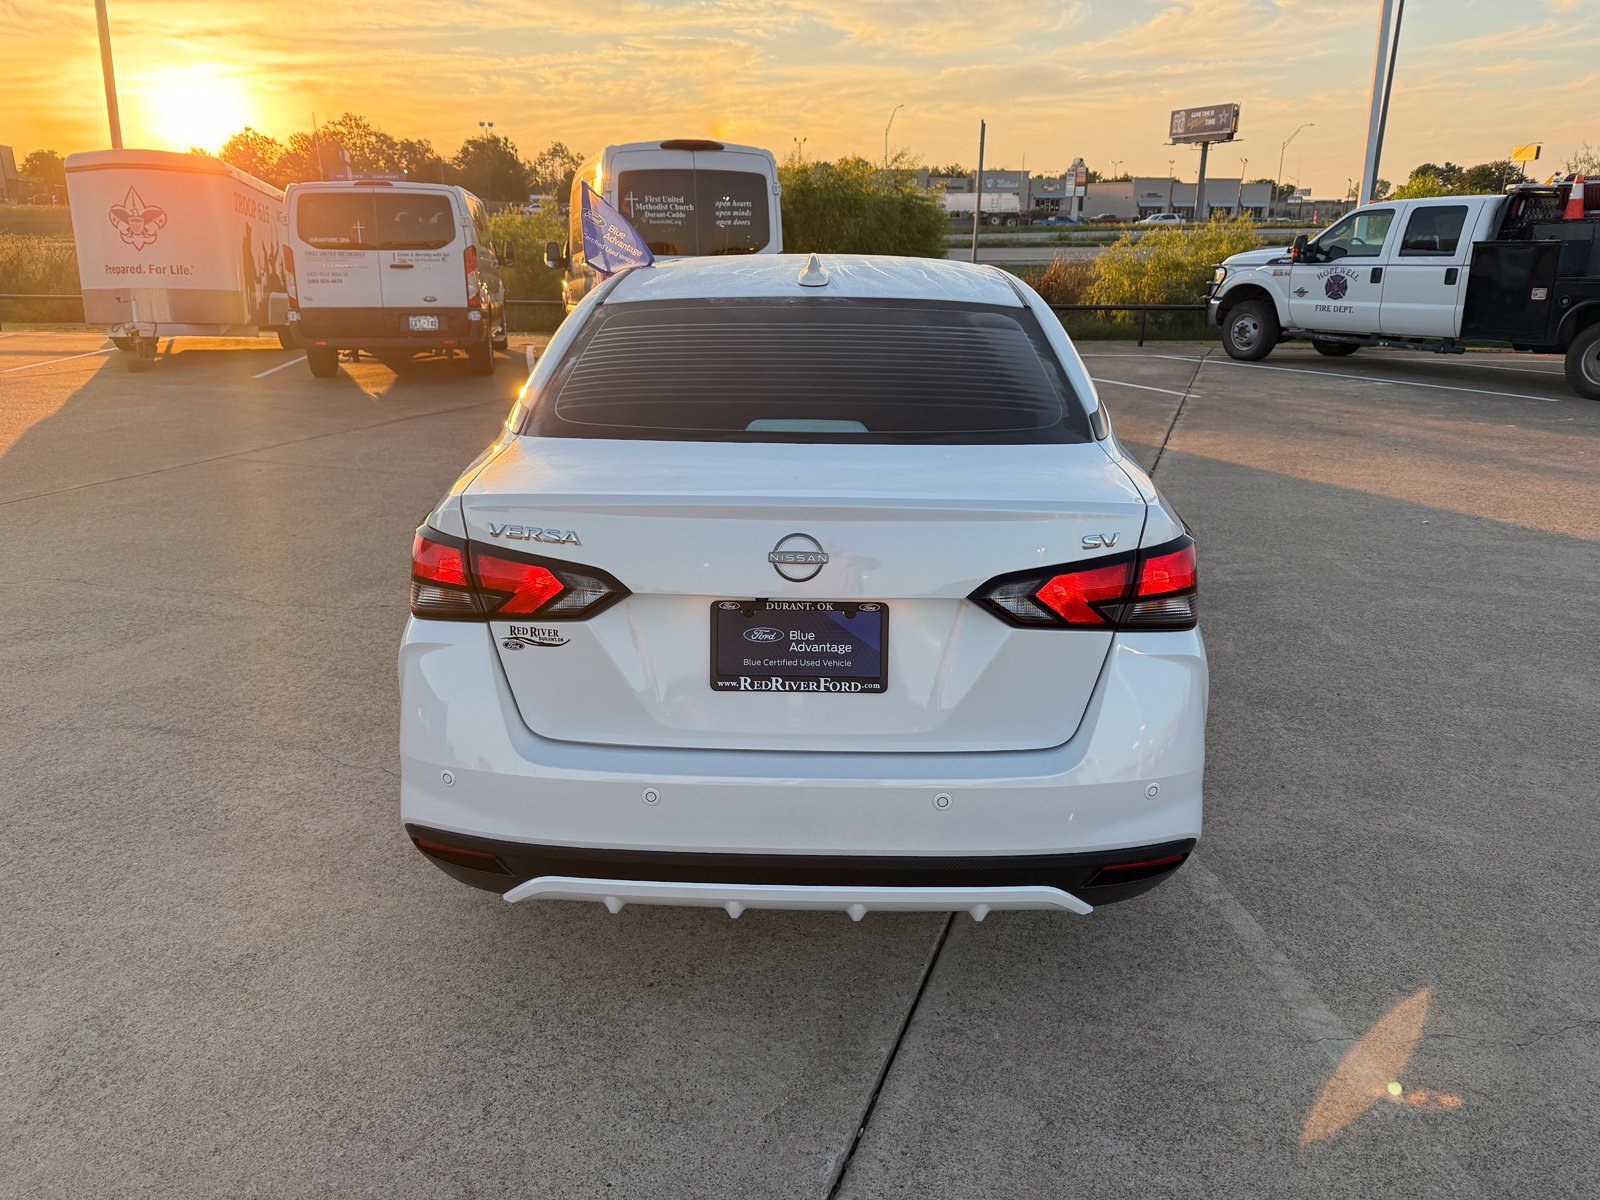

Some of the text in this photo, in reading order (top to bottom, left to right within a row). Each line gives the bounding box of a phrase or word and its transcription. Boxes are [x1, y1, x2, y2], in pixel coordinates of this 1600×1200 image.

[232, 191, 256, 218] TROOP
[608, 224, 626, 239] Blue
[584, 232, 636, 266] Certified Used Vehicle
[603, 233, 643, 256] Advantage
[105, 264, 146, 276] Prepared.
[149, 264, 166, 275] For
[1316, 266, 1360, 281] HOPEWELL
[1315, 304, 1354, 314] FIRE DEPT.
[488, 522, 582, 546] VERSA
[1082, 532, 1120, 550] SV
[770, 554, 826, 562] NISSAN
[766, 602, 834, 611] DURANT, OK
[509, 625, 559, 637] RED RIVER
[748, 628, 780, 642] Ford
[789, 630, 815, 641] Blue
[789, 642, 852, 654] Advantage
[743, 658, 852, 667] Blue Certified Used Vehicle
